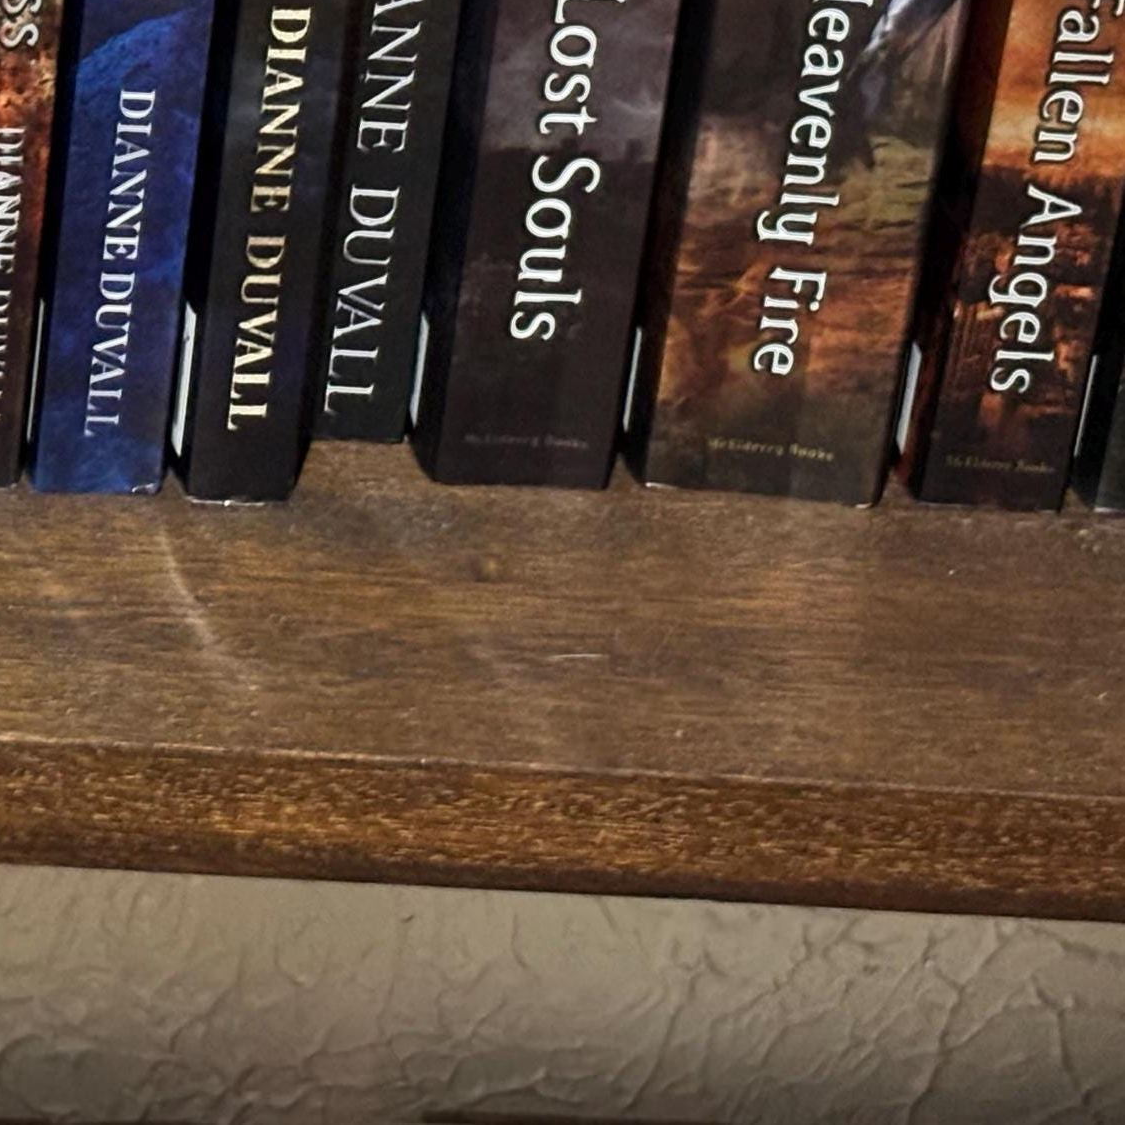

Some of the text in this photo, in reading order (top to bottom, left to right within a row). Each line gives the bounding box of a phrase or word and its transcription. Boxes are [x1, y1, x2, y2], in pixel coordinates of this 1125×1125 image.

[83, 89, 156, 438] DIANNE DUVALL
[227, 6, 312, 431] DIANNE DUVALL
[324, 184, 401, 416] DUVALL
[509, 155, 601, 342] Souls
[752, 267, 827, 377] Fire
[988, 183, 1083, 395] Angels
